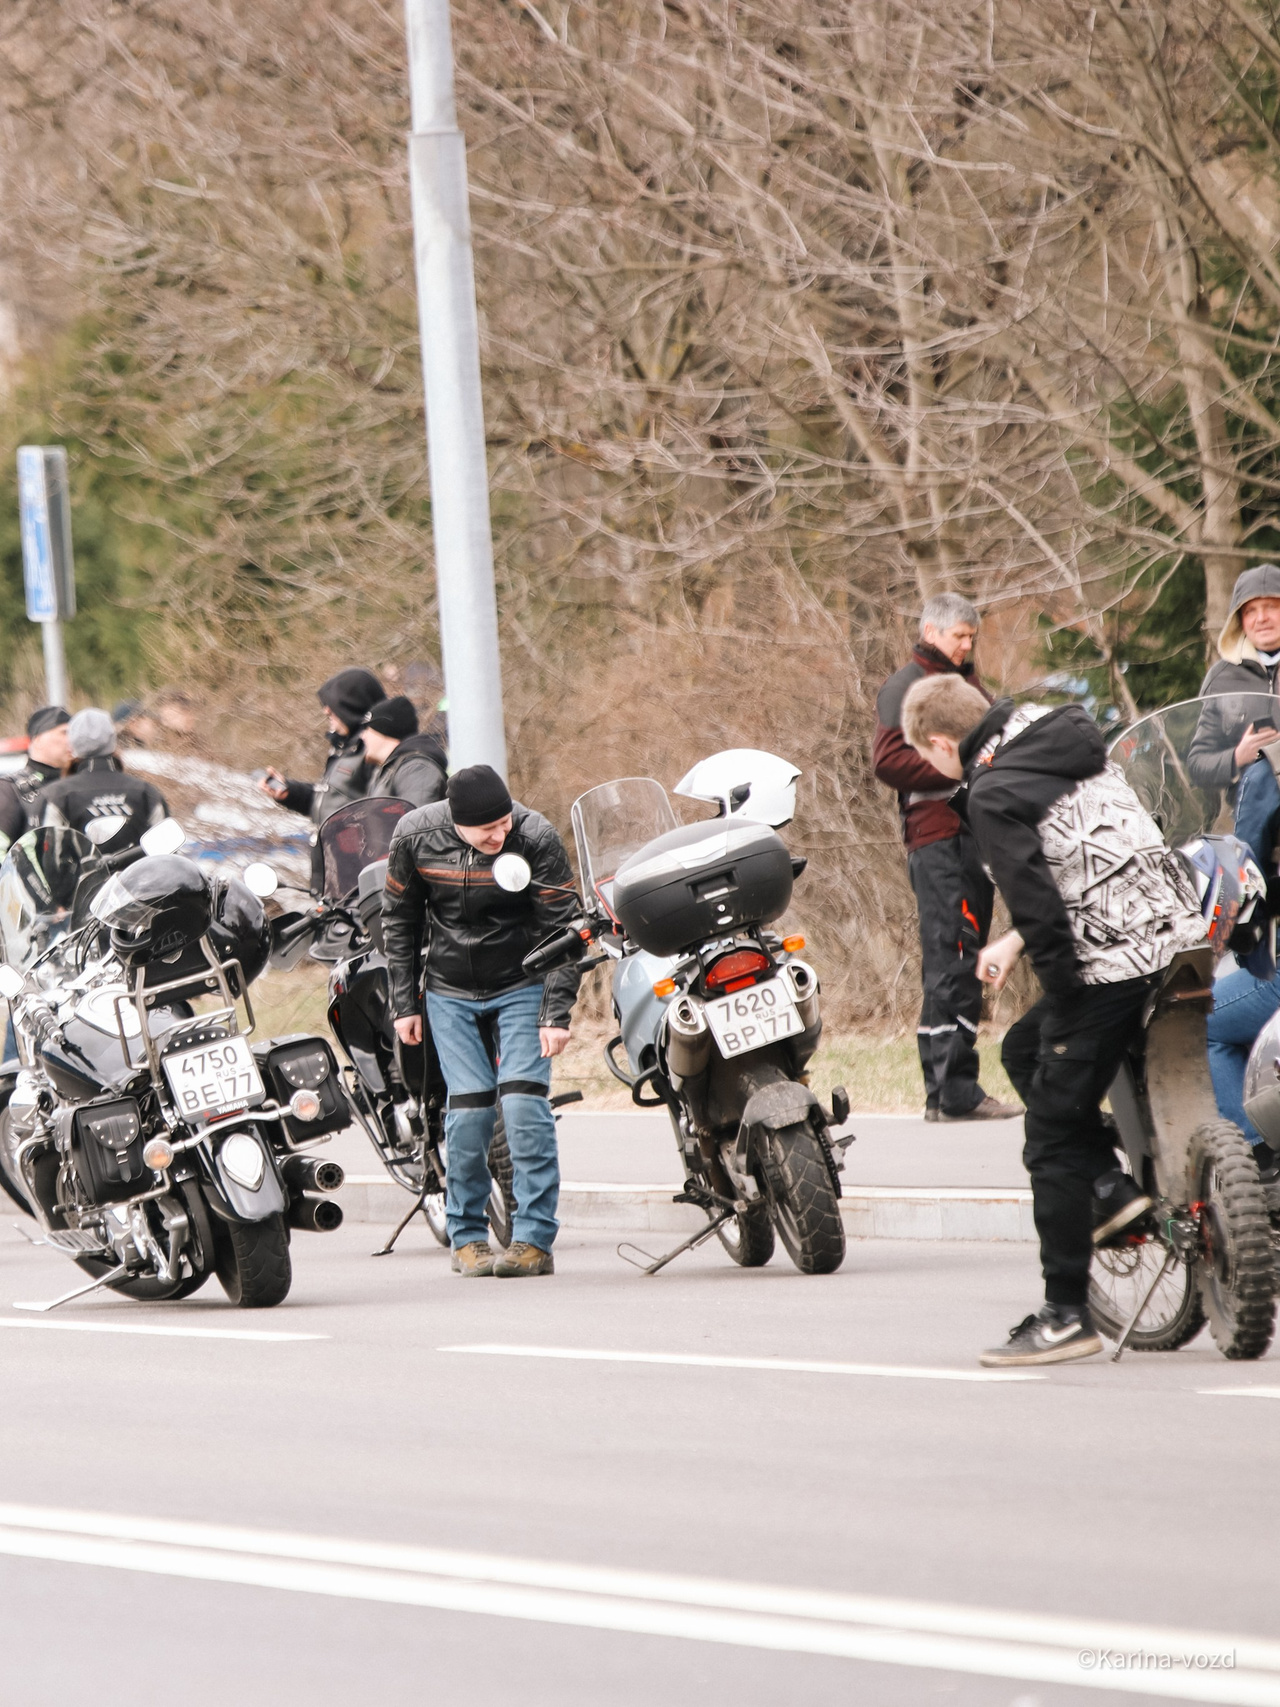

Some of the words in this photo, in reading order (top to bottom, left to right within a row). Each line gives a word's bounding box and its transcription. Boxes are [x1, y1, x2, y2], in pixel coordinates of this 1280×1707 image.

[717, 988, 776, 1022] 7620
[754, 1008, 776, 1020] RUS
[723, 1025, 756, 1051] ВР
[764, 1012, 791, 1037] 77
[182, 1045, 238, 1077] 4750
[215, 1067, 237, 1079] RUS
[182, 1083, 220, 1111] ВЕ
[224, 1072, 252, 1097] 77
[216, 1099, 250, 1114] YAMAHA
